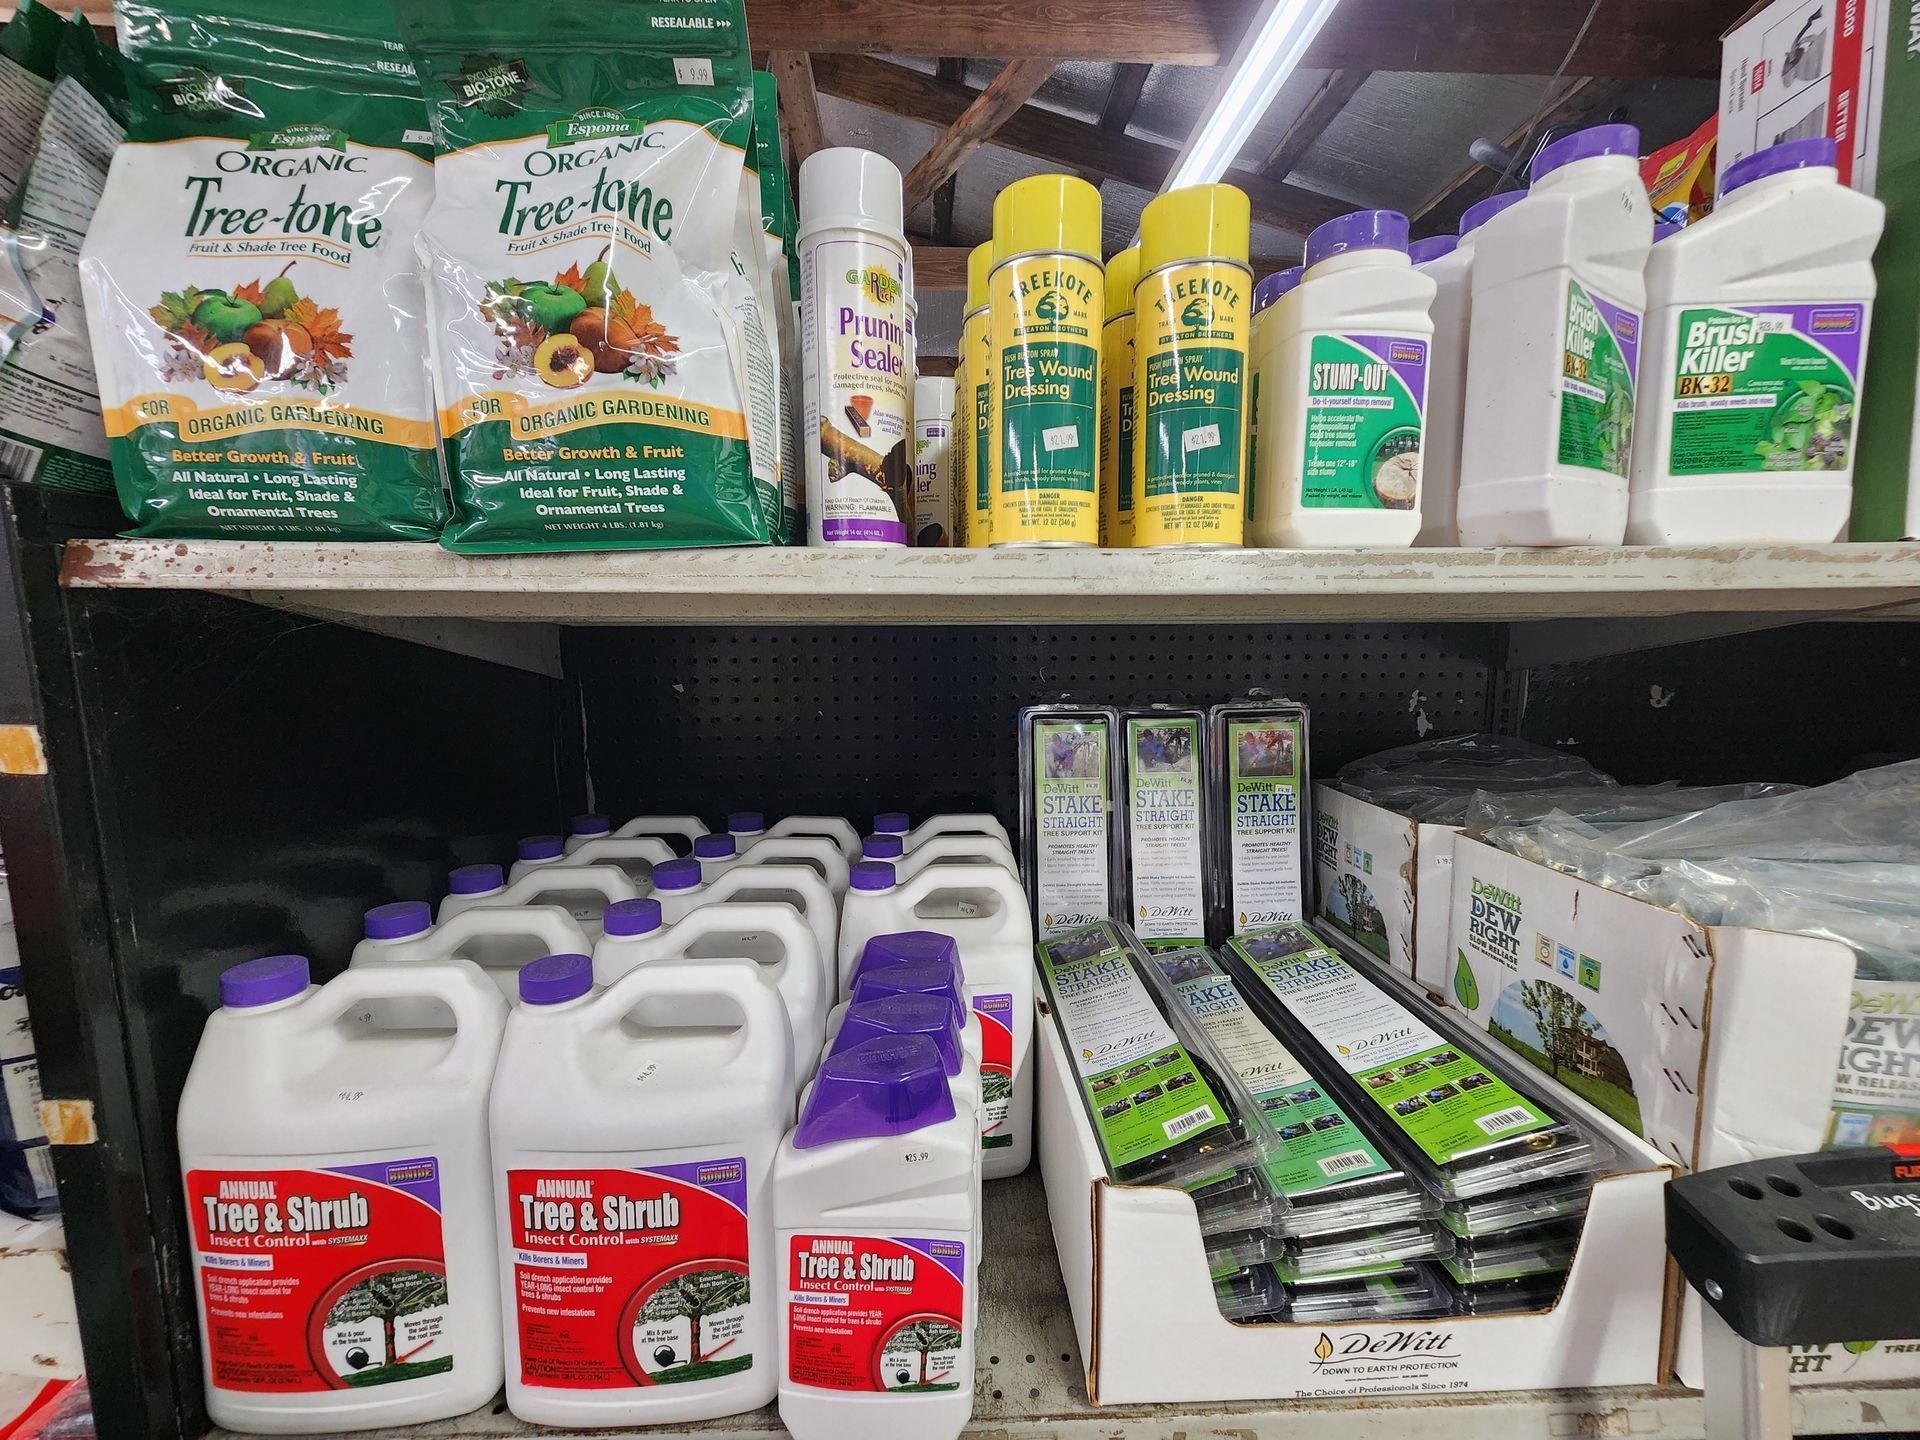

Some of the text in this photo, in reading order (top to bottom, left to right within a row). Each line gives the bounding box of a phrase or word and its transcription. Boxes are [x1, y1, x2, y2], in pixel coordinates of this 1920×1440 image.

[651, 17, 714, 28] RESEALABLE
[383, 41, 404, 52] TEAR
[463, 71, 521, 97] BIO-TONE
[690, 67, 708, 81] 9.99
[1835, 89, 1850, 143] BETTER
[566, 121, 631, 136] Espoma
[216, 151, 366, 177] ORGANIC
[524, 131, 664, 177] ORGANIC
[185, 177, 382, 249] Tree-tone
[496, 167, 673, 241] Tree-tone
[508, 221, 651, 253] Fruit & Shade Tree Food
[190, 240, 351, 264] Fruit & Shade Tree Food
[1009, 271, 1092, 304] TREEKOTE
[1154, 278, 1239, 312] TREEKOTE
[1569, 294, 1599, 337] Brush
[1052, 325, 1086, 335] BROTHERS
[1686, 317, 1765, 348] Brush
[1566, 328, 1595, 360] Killer
[851, 340, 904, 377] Sealer
[1185, 355, 1203, 364] SPRAY
[1565, 352, 1587, 379] BK-32
[1679, 346, 1755, 375] Killer
[833, 373, 869, 381] Protective
[1004, 360, 1093, 381] Tree Wound
[1149, 366, 1239, 389] Tree Wound
[1313, 363, 1389, 392] STUMP-OUT
[833, 382, 884, 392] damaged trees,
[1005, 379, 1070, 400] Dressing
[1150, 385, 1215, 407] Dressing
[1679, 375, 1731, 396] BK-32
[472, 398, 501, 417] FOR
[1312, 398, 1351, 406] Do-it-yourself
[520, 400, 710, 433] ORGANIC GARDENING
[503, 446, 684, 462] Better Growth & Fruit
[504, 468, 685, 482] All Natural Long Lasting
[520, 485, 684, 499] Ideal for Fruit, Shade &
[535, 502, 665, 515] Ornamental Trees
[545, 523, 561, 531] NET
[564, 523, 599, 531] WEIGHT
[609, 522, 627, 530] LBS.
[651, 521, 664, 530] kg)
[1237, 783, 1272, 793] DeWitt
[1237, 793, 1296, 813] STAKE
[1237, 814, 1296, 828] STRAIGHT
[1317, 822, 1338, 847] DEW
[1471, 876, 1522, 914] DeWitt
[1251, 912, 1293, 922] DeWitt
[1470, 895, 1522, 936] DEW
[1469, 916, 1520, 956] RIGHT
[1469, 934, 1518, 966] SLOW RELEASE
[1055, 957, 1125, 986] STAKE
[1266, 956, 1340, 982] STAKE
[1276, 967, 1349, 991] STRAIGHT
[1059, 968, 1129, 994] STRAIGHT
[1095, 1030, 1155, 1054] DeWitt
[1349, 1027, 1412, 1050] DeWitt
[905, 1152, 929, 1162] $25.99
[699, 1168, 741, 1184] BONIDE
[536, 1179, 593, 1199] ANNUAL
[519, 1192, 680, 1232] Tree & Shrub
[525, 1231, 679, 1246] Insect Control SYSTEMAXX
[811, 1239, 854, 1255] ANNUAL
[518, 1252, 585, 1266] Kills Borers & Miners
[799, 1252, 914, 1281] Tree & Shrub
[520, 1271, 613, 1284] Soil drench application provides
[521, 1281, 604, 1293] YEAR-LONG insect control for
[800, 1280, 874, 1292] Insect Control
[521, 1290, 561, 1302] trees & shrubs
[522, 1304, 595, 1317] Prevents new infestations
[1339, 1331, 1452, 1354] DeWitt
[1322, 1367, 1350, 1375] DOWN
[1367, 1364, 1397, 1373] EARTH
[1400, 1362, 1458, 1371] PROTECTION
[1359, 1383, 1419, 1393] Professionals
